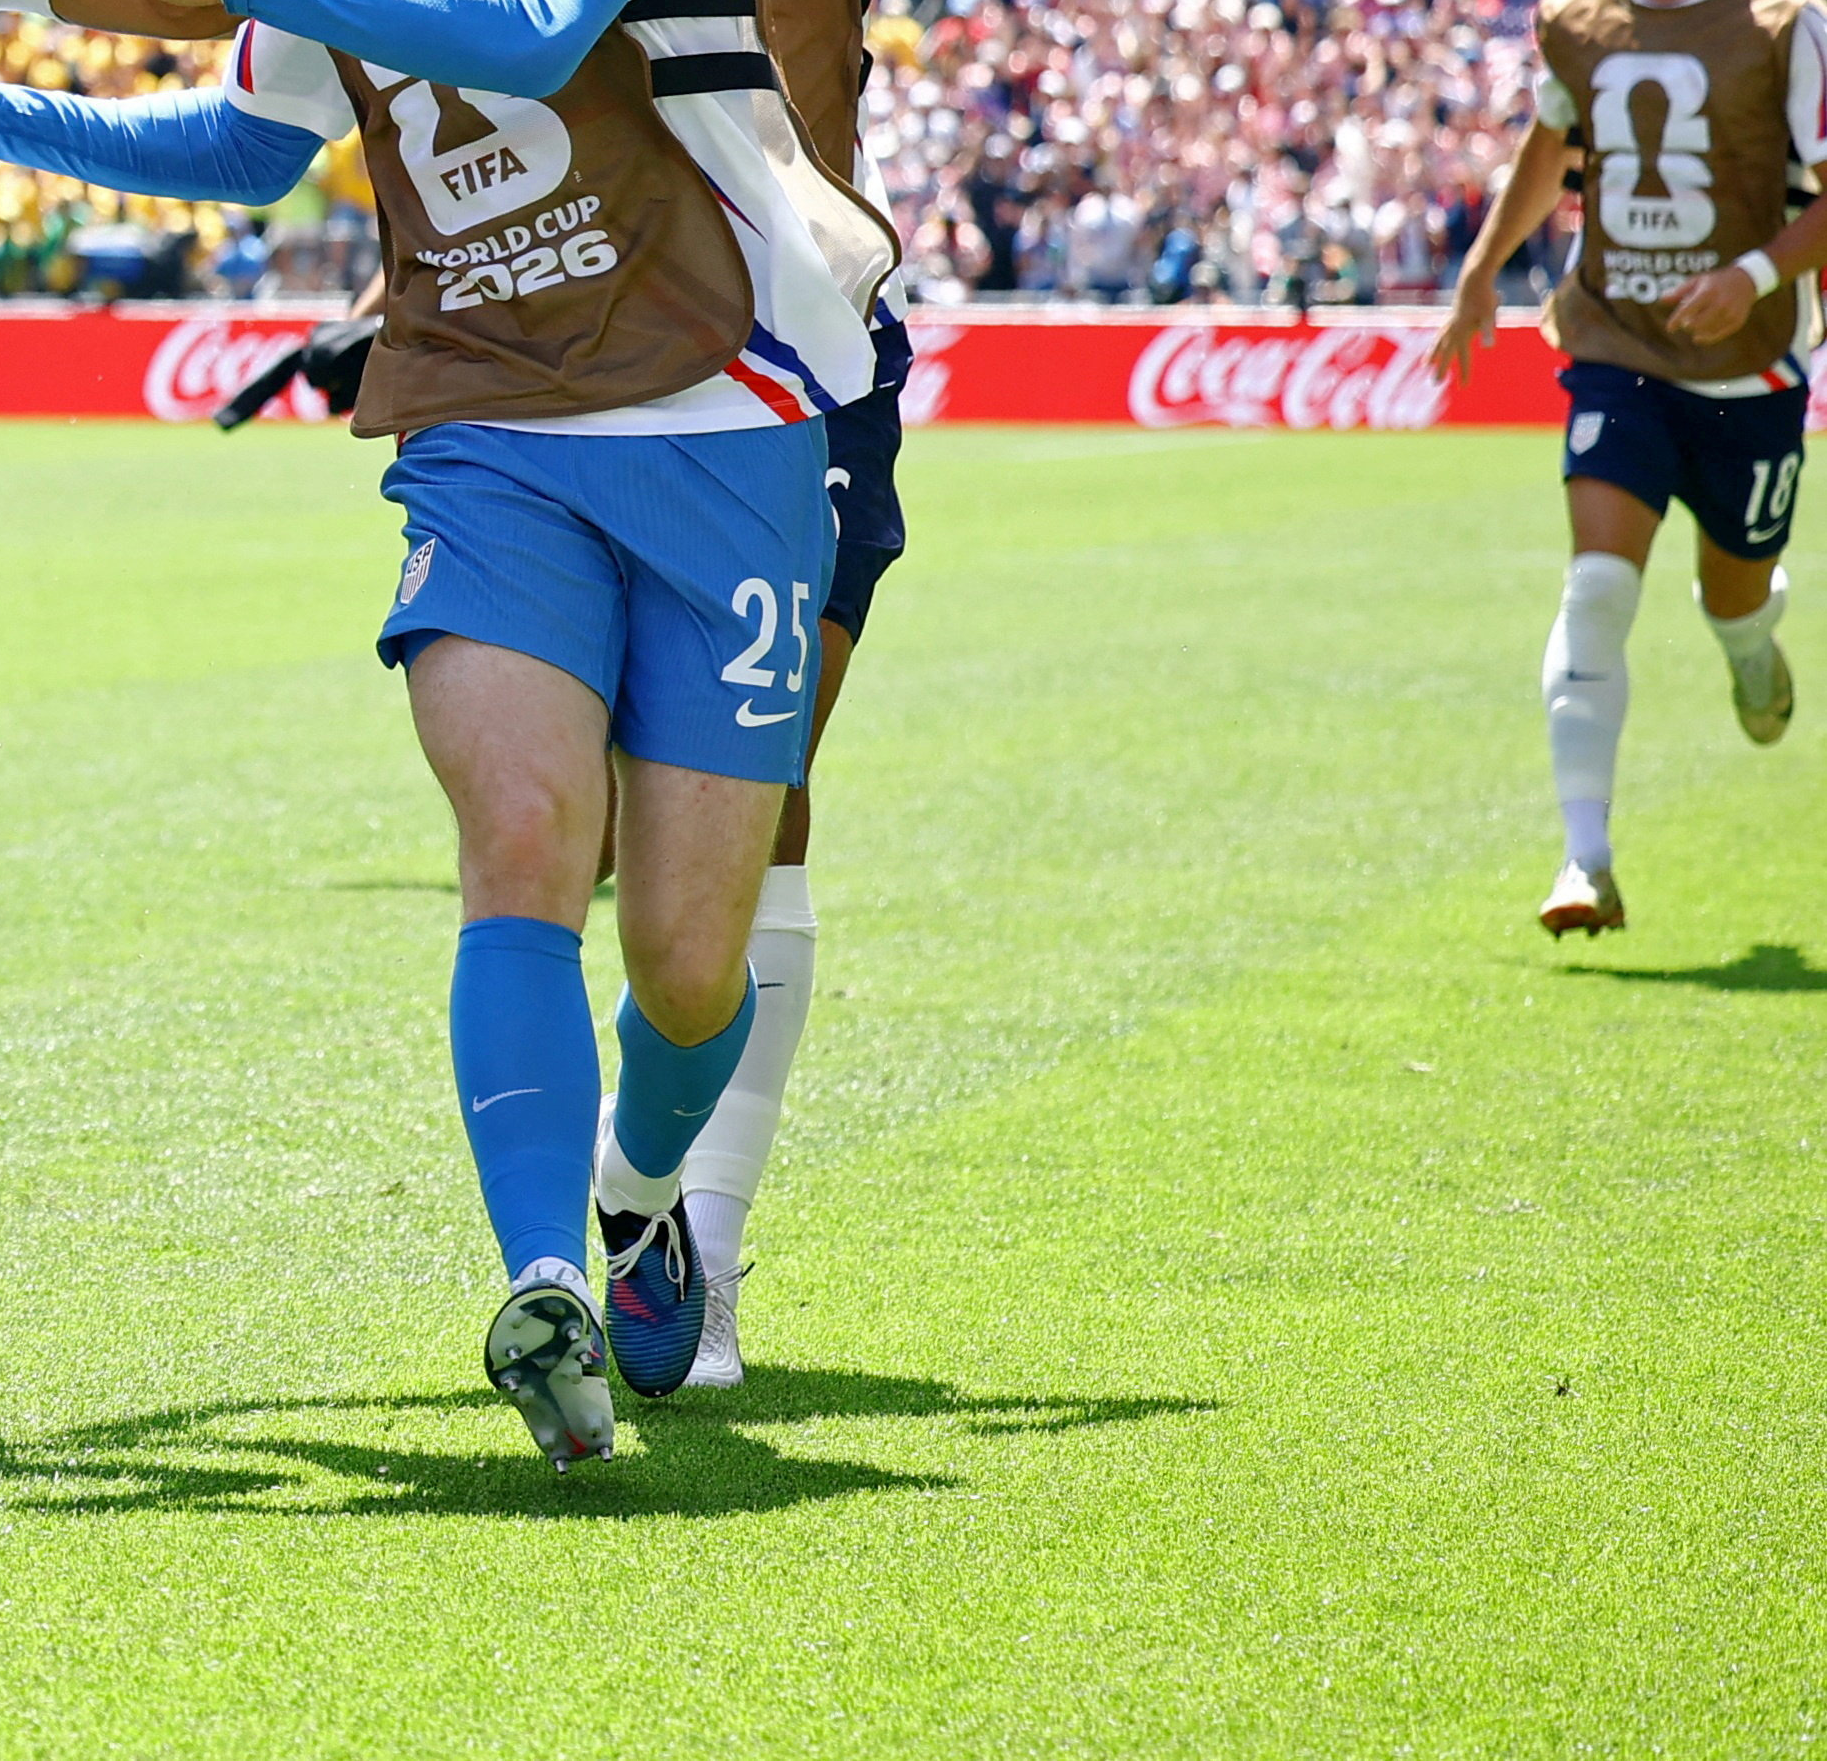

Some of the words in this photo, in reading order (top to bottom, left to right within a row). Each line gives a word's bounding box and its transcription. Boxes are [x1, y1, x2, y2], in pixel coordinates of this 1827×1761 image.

[440, 146, 529, 202] FIFA
[415, 225, 532, 268] WORLD
[534, 195, 601, 239] CUP
[1628, 210, 1679, 230] FIFA
[437, 229, 619, 312] 2026
[1603, 249, 1673, 273] WORLD
[1674, 249, 1720, 273] CUP
[1127, 323, 1450, 430] Coca-Cola
[1745, 451, 1800, 527] 18
[407, 543, 434, 574] USA
[720, 577, 810, 693] 25
